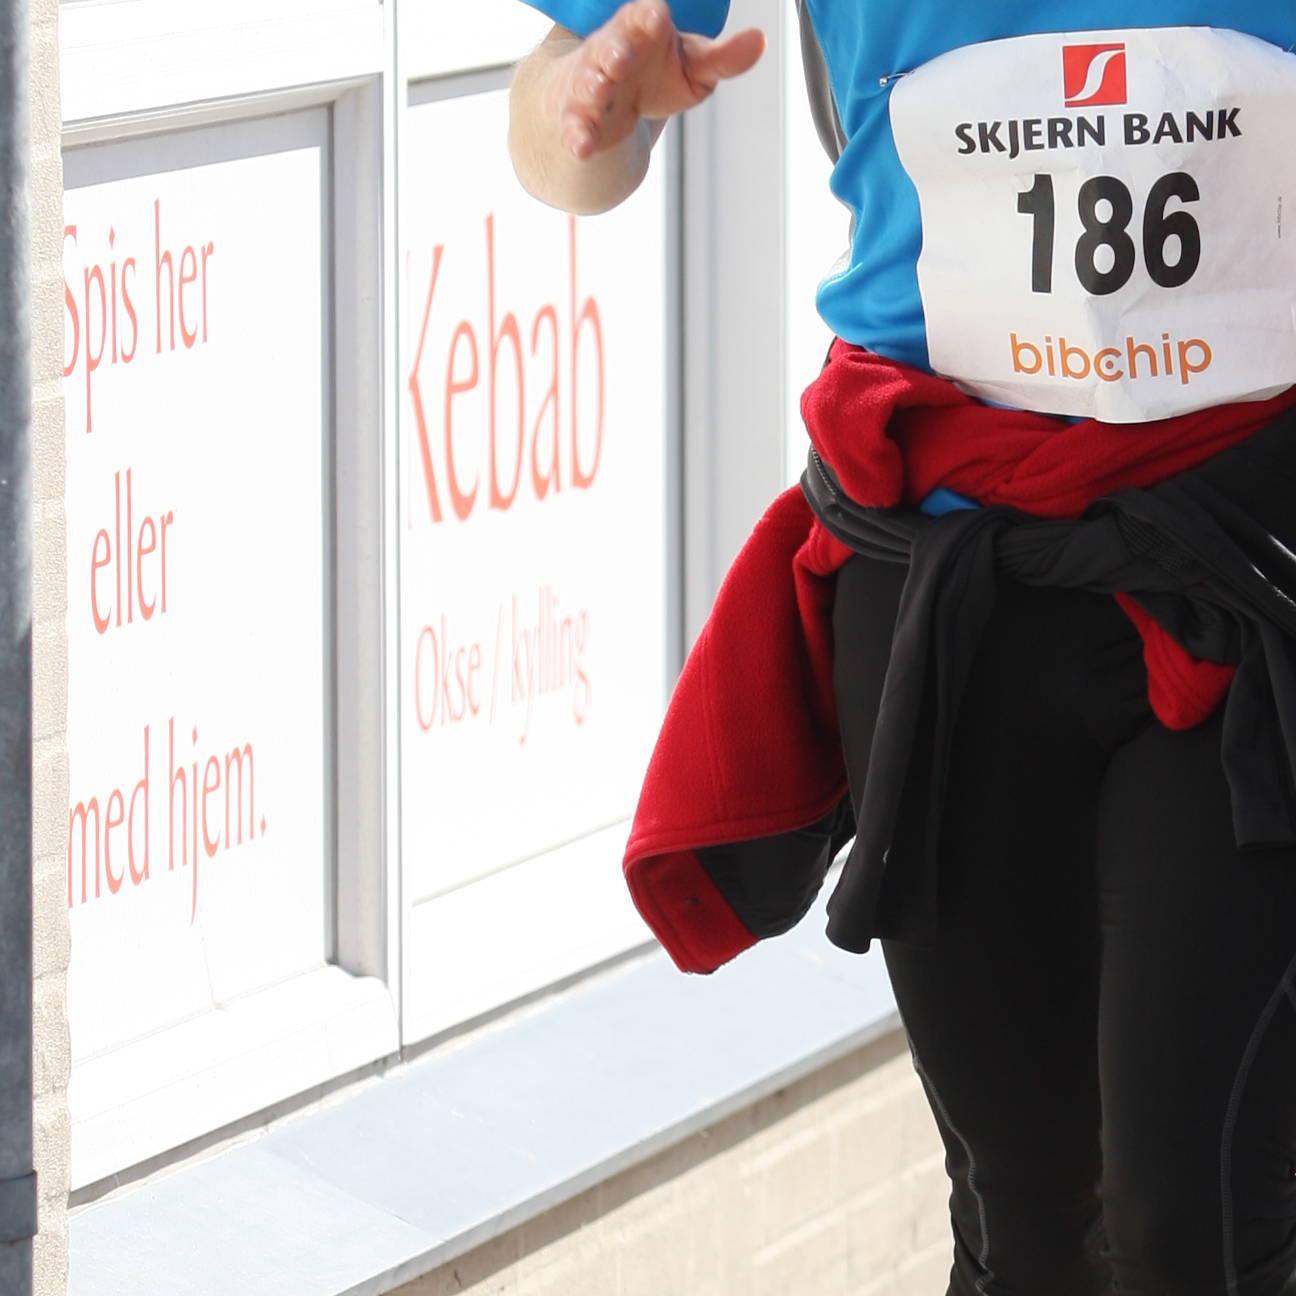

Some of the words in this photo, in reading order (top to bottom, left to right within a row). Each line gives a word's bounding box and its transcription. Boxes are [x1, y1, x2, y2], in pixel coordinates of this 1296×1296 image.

[954, 115, 1106, 160] SKJERN
[1123, 107, 1242, 146] BANK
[1016, 171, 1201, 296] 186
[63, 224, 138, 434] Spis
[154, 197, 214, 354] her
[1010, 333, 1212, 385] bibchip
[90, 467, 174, 635] eller
[414, 612, 484, 733] Okse
[67, 724, 150, 909] med
[168, 716, 267, 927] hjem.
